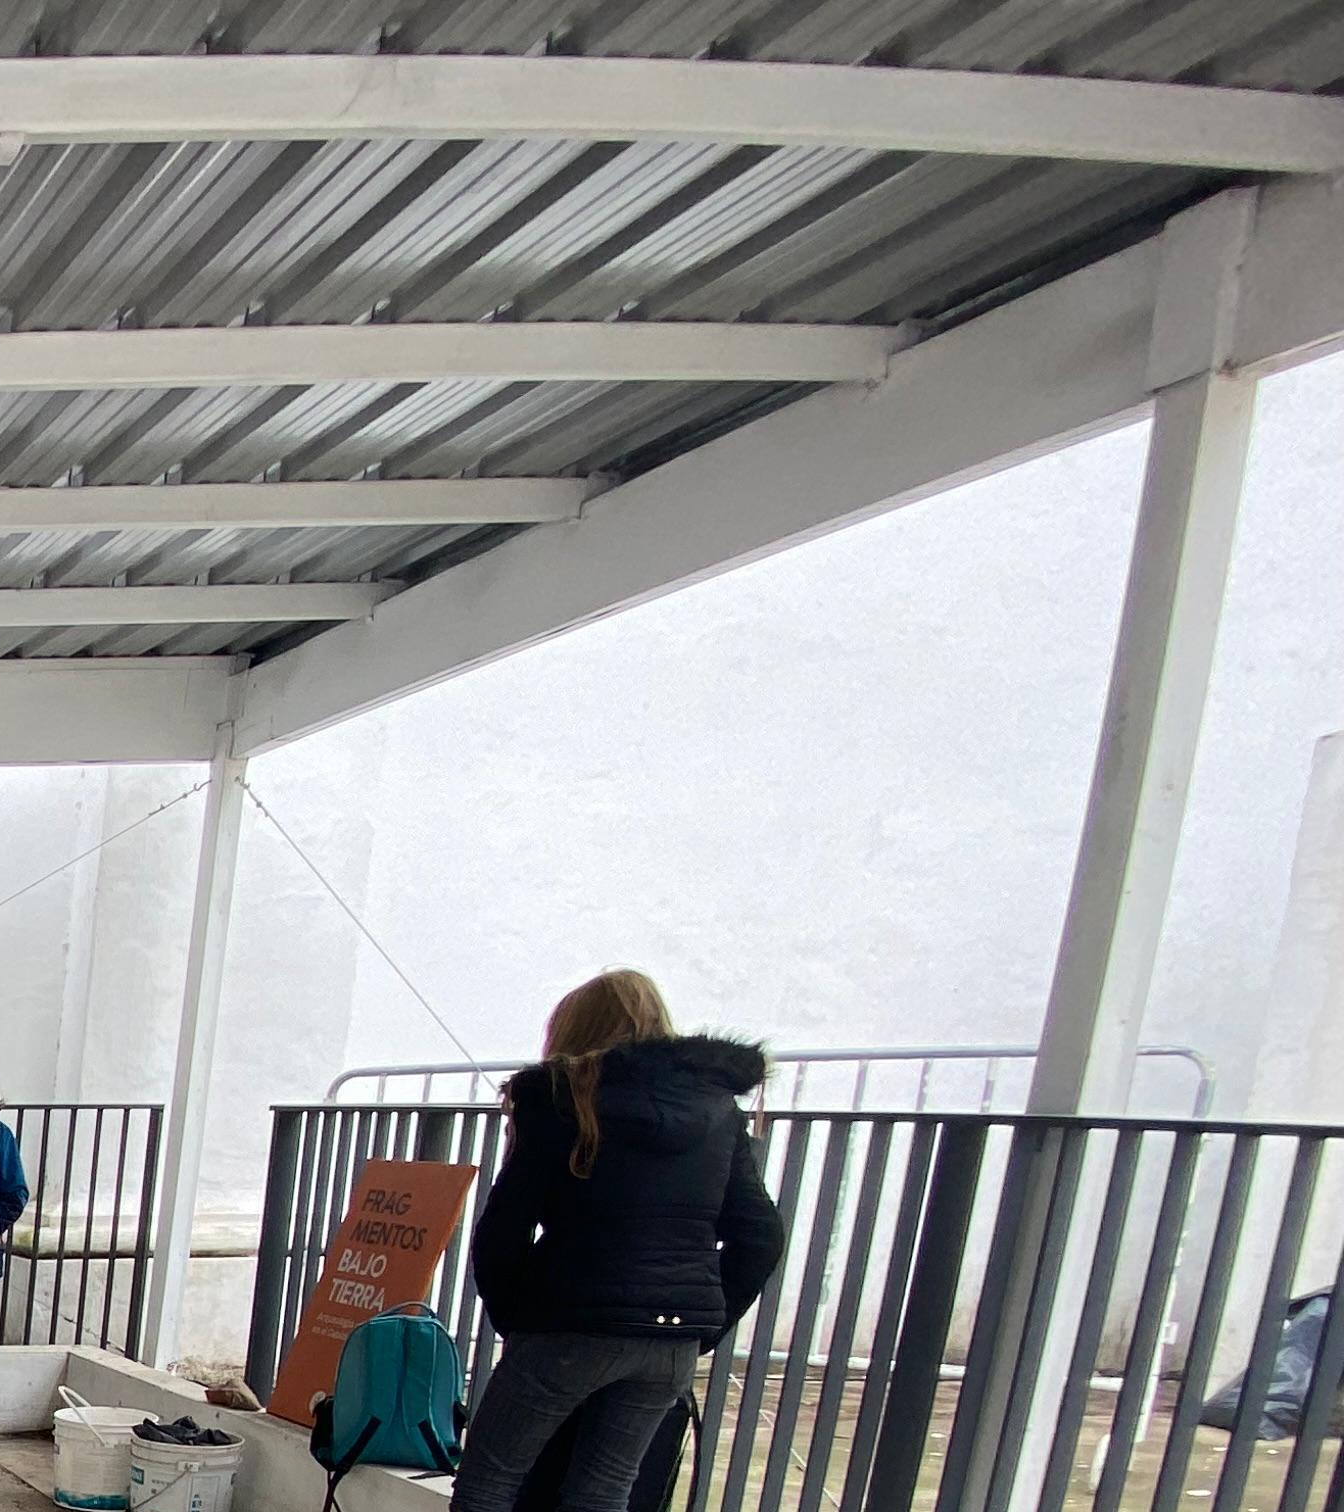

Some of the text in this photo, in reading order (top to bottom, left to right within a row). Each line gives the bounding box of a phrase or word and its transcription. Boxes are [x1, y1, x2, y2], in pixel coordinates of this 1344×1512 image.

[362, 1188, 412, 1216] FRAG
[349, 1219, 428, 1251] MENTOS
[337, 1248, 388, 1278] BAJO
[329, 1278, 386, 1312] TIERRA
